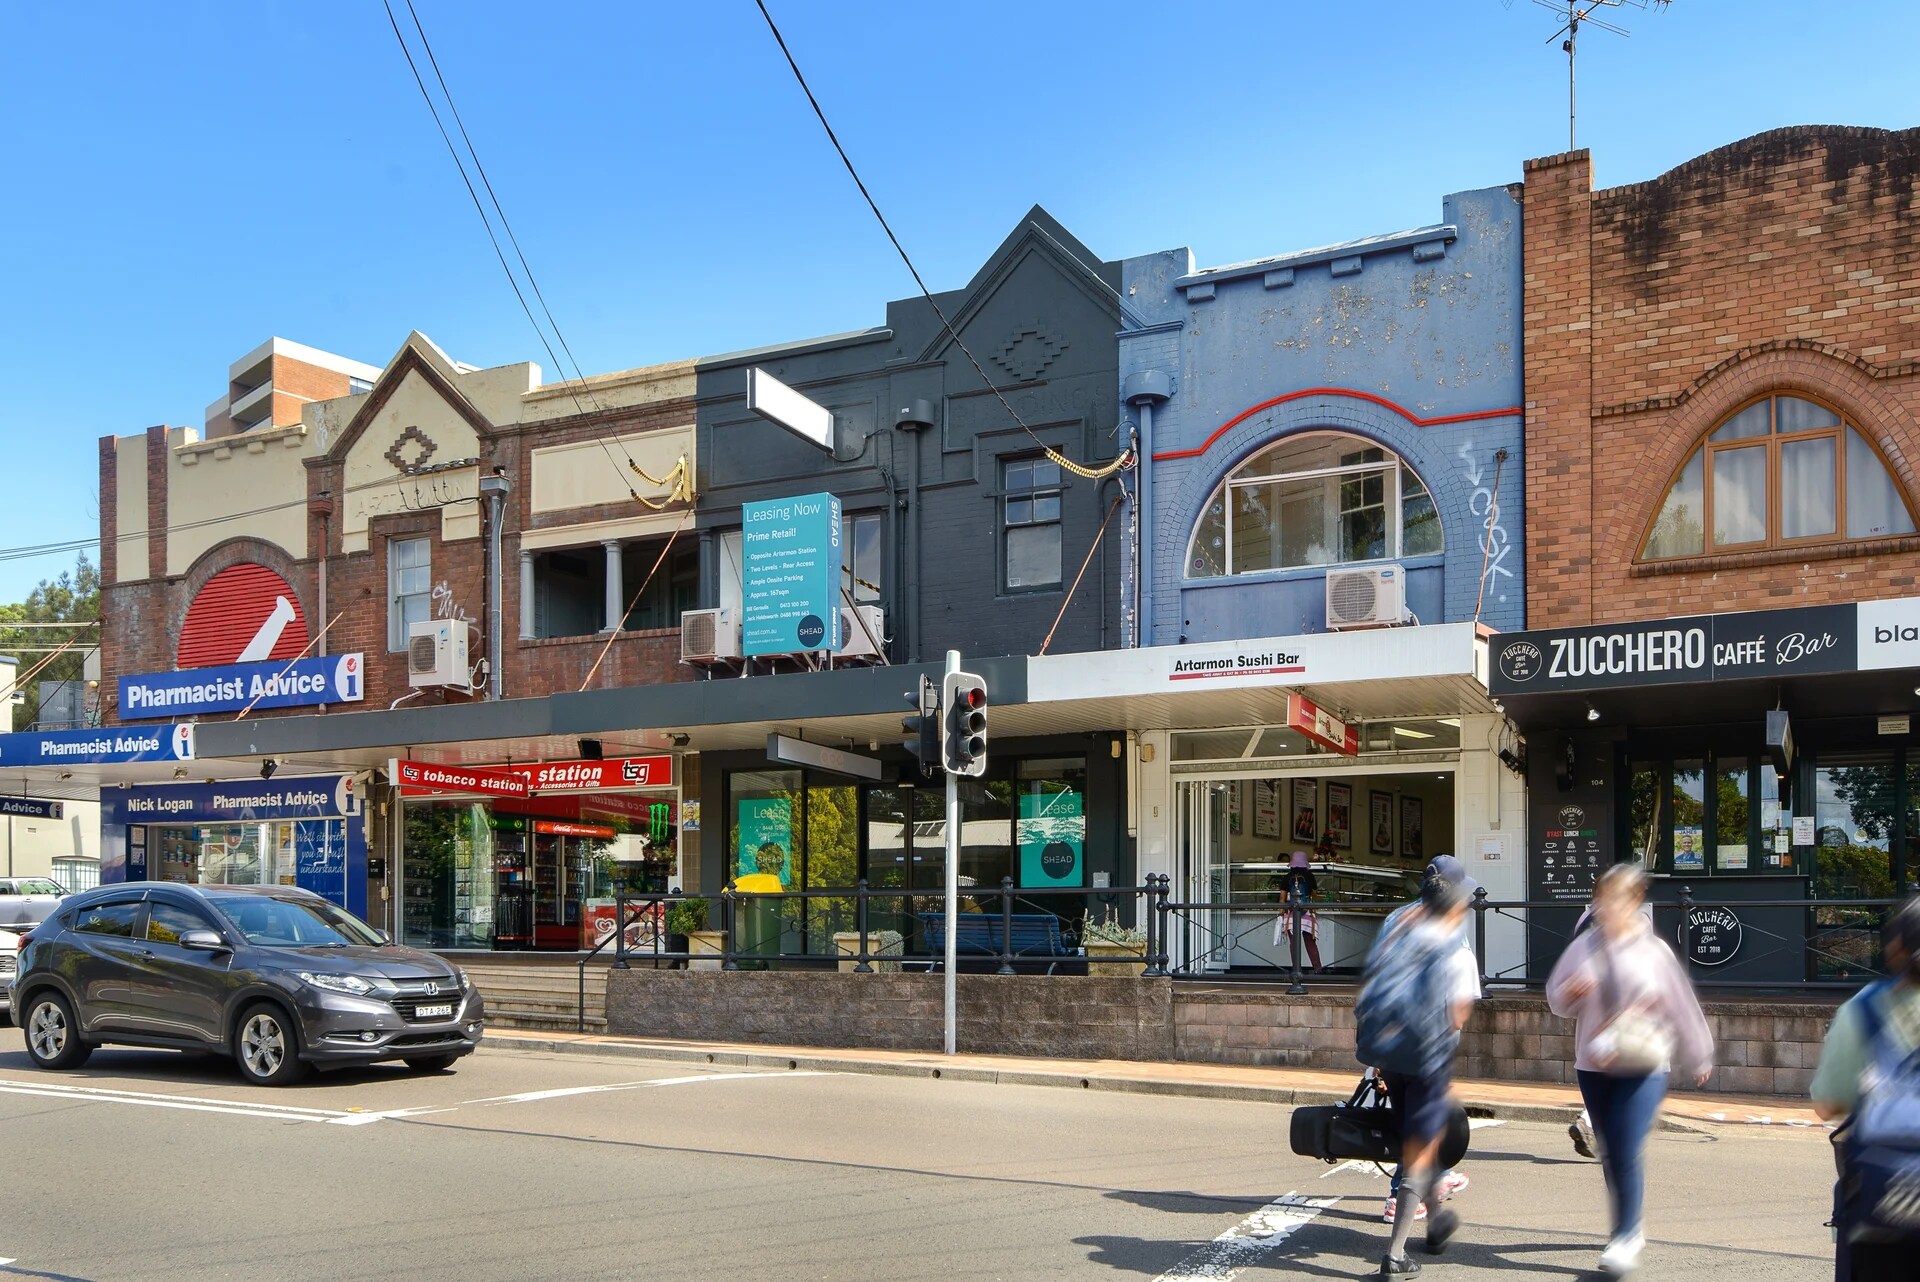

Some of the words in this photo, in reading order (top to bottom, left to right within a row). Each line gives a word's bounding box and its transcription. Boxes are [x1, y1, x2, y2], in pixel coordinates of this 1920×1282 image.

[746, 506, 791, 522] Leasing
[794, 503, 821, 517] Now
[831, 500, 839, 547] SHEAD
[747, 532, 770, 543] Prime
[771, 528, 797, 539] Retail!
[750, 552, 772, 561] Opposite
[772, 549, 797, 558] Artarmon
[798, 547, 817, 555] Station
[761, 564, 778, 572] Levels
[783, 574, 804, 582] Parking
[799, 626, 823, 636] SHEAD
[1874, 624, 1918, 644] bla
[1503, 644, 1539, 660] ZUCCHERO
[1548, 628, 1705, 679] ZUCCHERO
[1713, 635, 1765, 667] CAFFÉ
[1775, 631, 1838, 666] Bar
[1174, 659, 1233, 672] Artarmon
[1237, 653, 1273, 668] Sushi
[1277, 652, 1300, 665] Bar
[127, 677, 244, 709] Pharmacist
[248, 670, 326, 699] Advice
[40, 739, 112, 756] Pharmacist
[114, 736, 160, 753] Advice
[423, 769, 476, 786] tobacco
[480, 778, 524, 792] station
[537, 764, 603, 783] station
[540, 781, 577, 790] Accessories
[585, 780, 601, 788] Gifts
[2, 801, 43, 814] Advice
[128, 798, 154, 812] Nick
[157, 797, 193, 814] Logan
[213, 793, 282, 809] Pharmacist
[285, 791, 328, 806] Advice
[1043, 803, 1075, 815] ease
[753, 805, 785, 819] Lease
[757, 856, 782, 864] SHEAD
[1043, 855, 1073, 864] SHEAD
[1689, 910, 1737, 931] UCCHERO
[1702, 925, 1717, 934] CAFFÉ
[1700, 934, 1718, 944] Bar
[1697, 945, 1707, 954] EST
[1709, 945, 1721, 954] 2018
